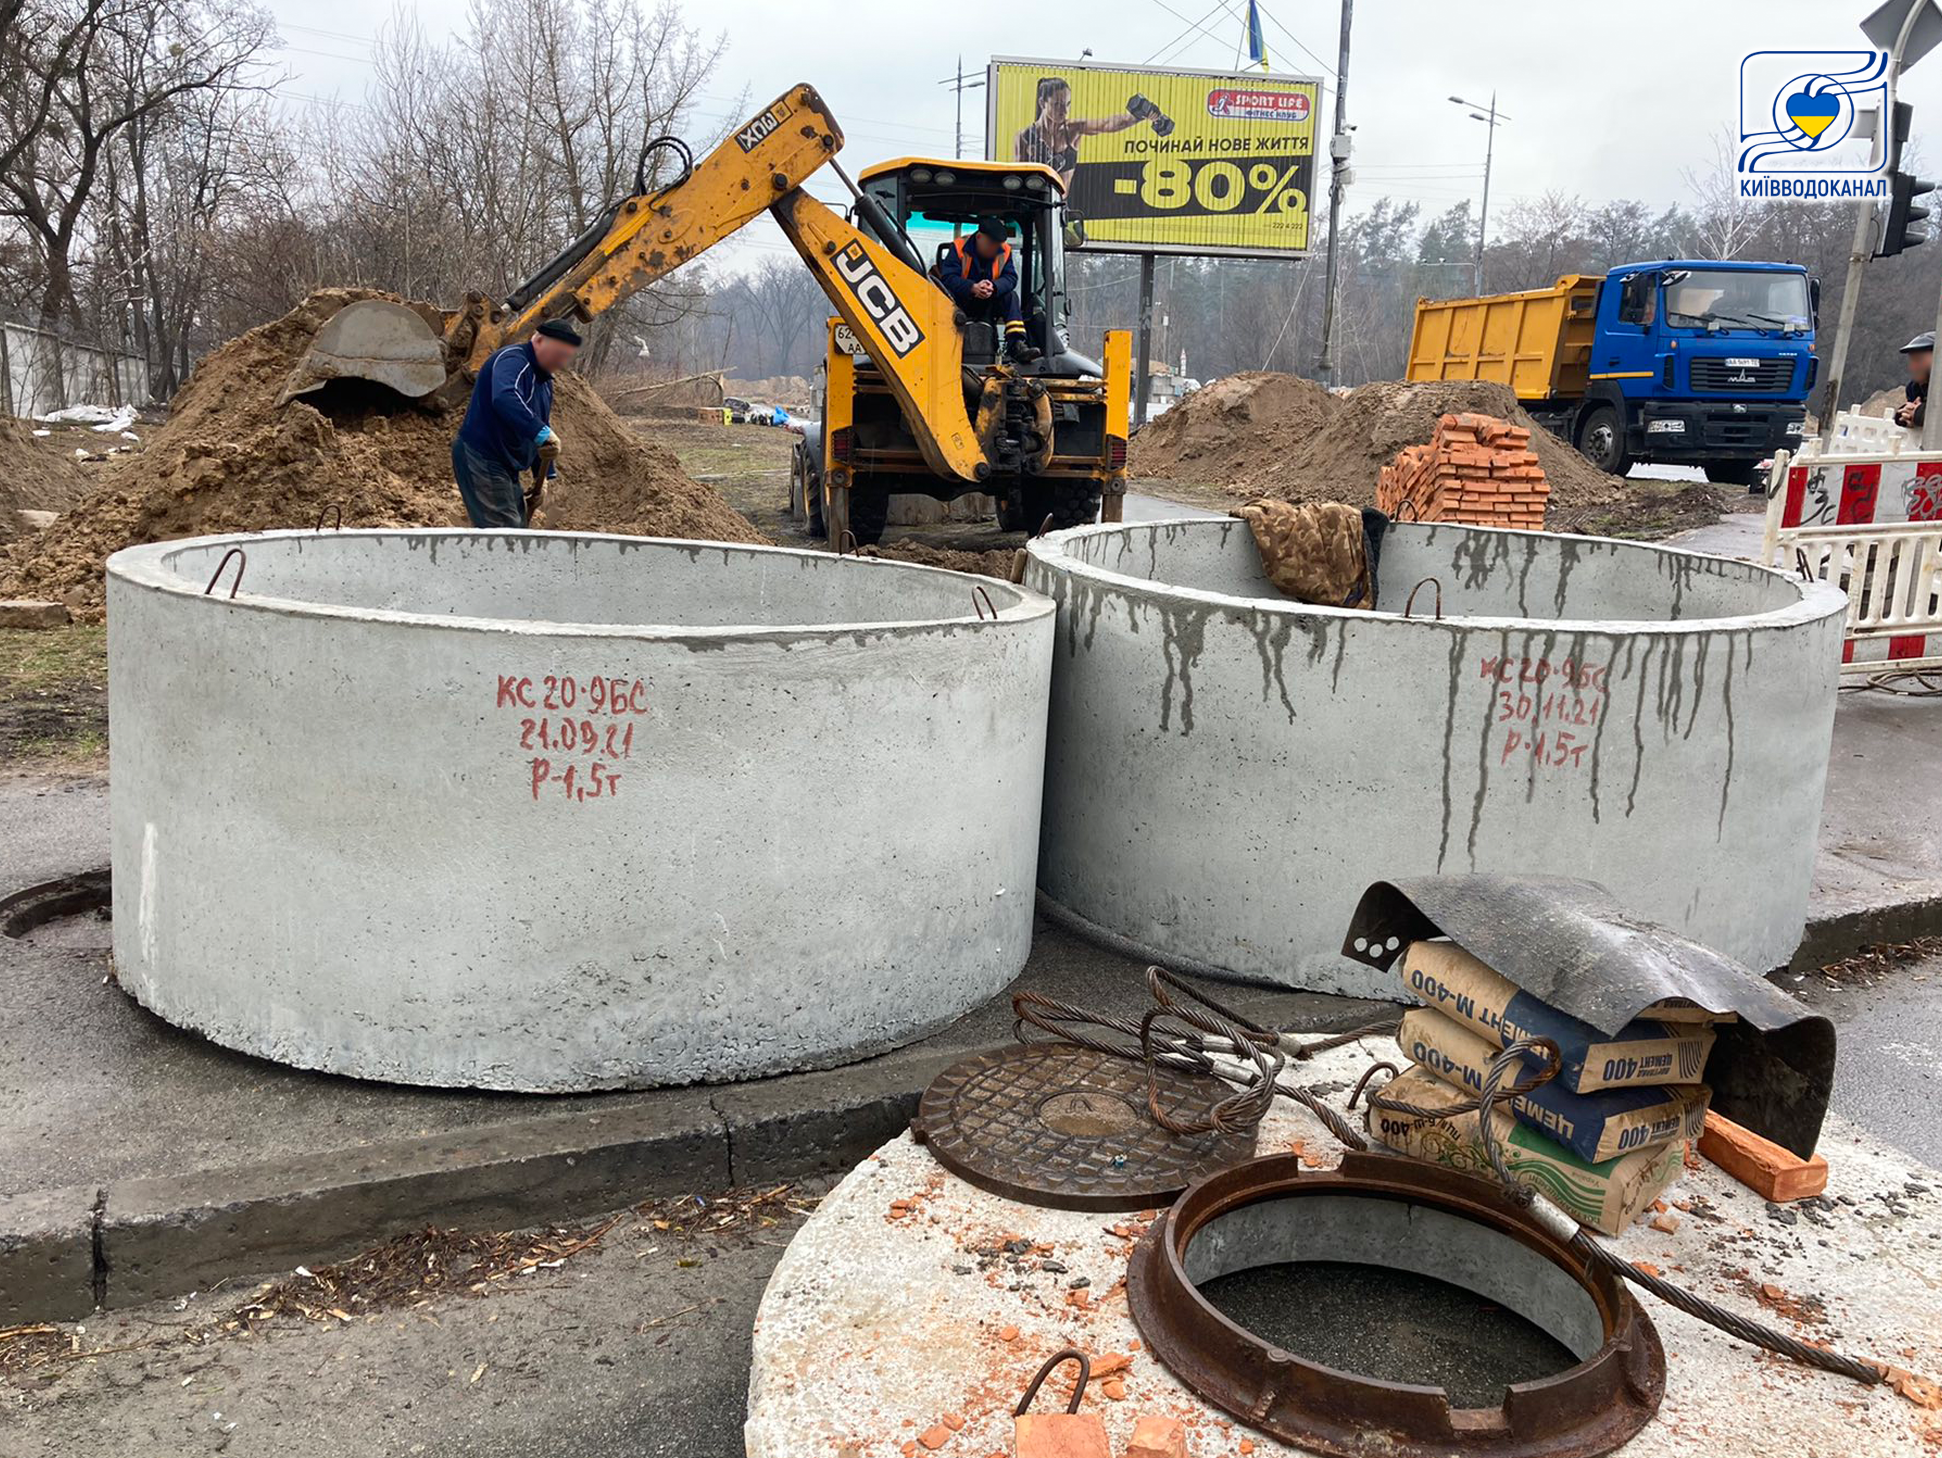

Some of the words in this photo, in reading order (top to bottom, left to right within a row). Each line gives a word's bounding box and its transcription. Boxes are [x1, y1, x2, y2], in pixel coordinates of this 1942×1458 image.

[1236, 94, 1275, 107] SPORT
[1278, 97, 1303, 109] LIFE
[1124, 135, 1203, 154] ПОЧИНАЙ
[1209, 138, 1251, 152] НОВЕ
[1255, 136, 1309, 151] ЖИТТЯ
[1113, 160, 1308, 214] -80%
[836, 252, 921, 353] JCB
[519, 717, 634, 760] 21.09.21
[1411, 969, 1474, 1018] М-400
[1413, 1041, 1482, 1092] М-400
[1603, 1056, 1638, 1081] 400
[1638, 1053, 1673, 1069] ЦЕМЕНТ
[1618, 1125, 1650, 1150] 400
